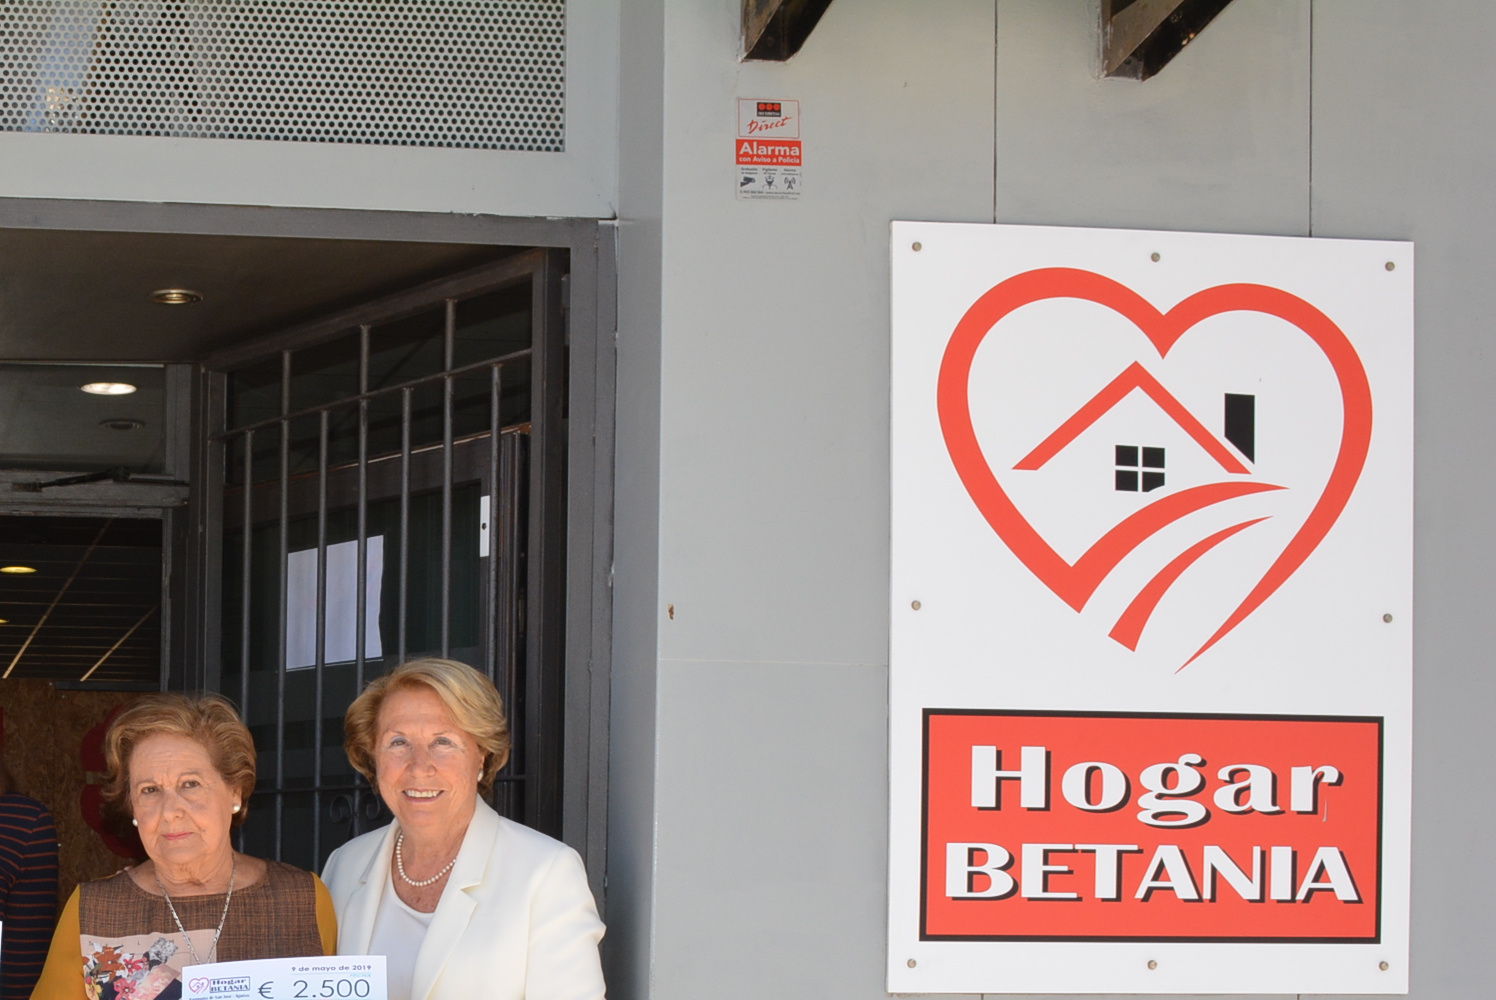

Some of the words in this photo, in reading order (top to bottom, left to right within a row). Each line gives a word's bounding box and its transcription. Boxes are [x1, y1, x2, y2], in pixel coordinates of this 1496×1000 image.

[747, 117, 792, 134] Direct
[739, 141, 800, 156] Alarma
[970, 744, 1344, 829] Hogar
[945, 842, 1364, 904] BETANIA
[211, 984, 249, 992] BETANIA
[293, 978, 370, 998] 2.500
